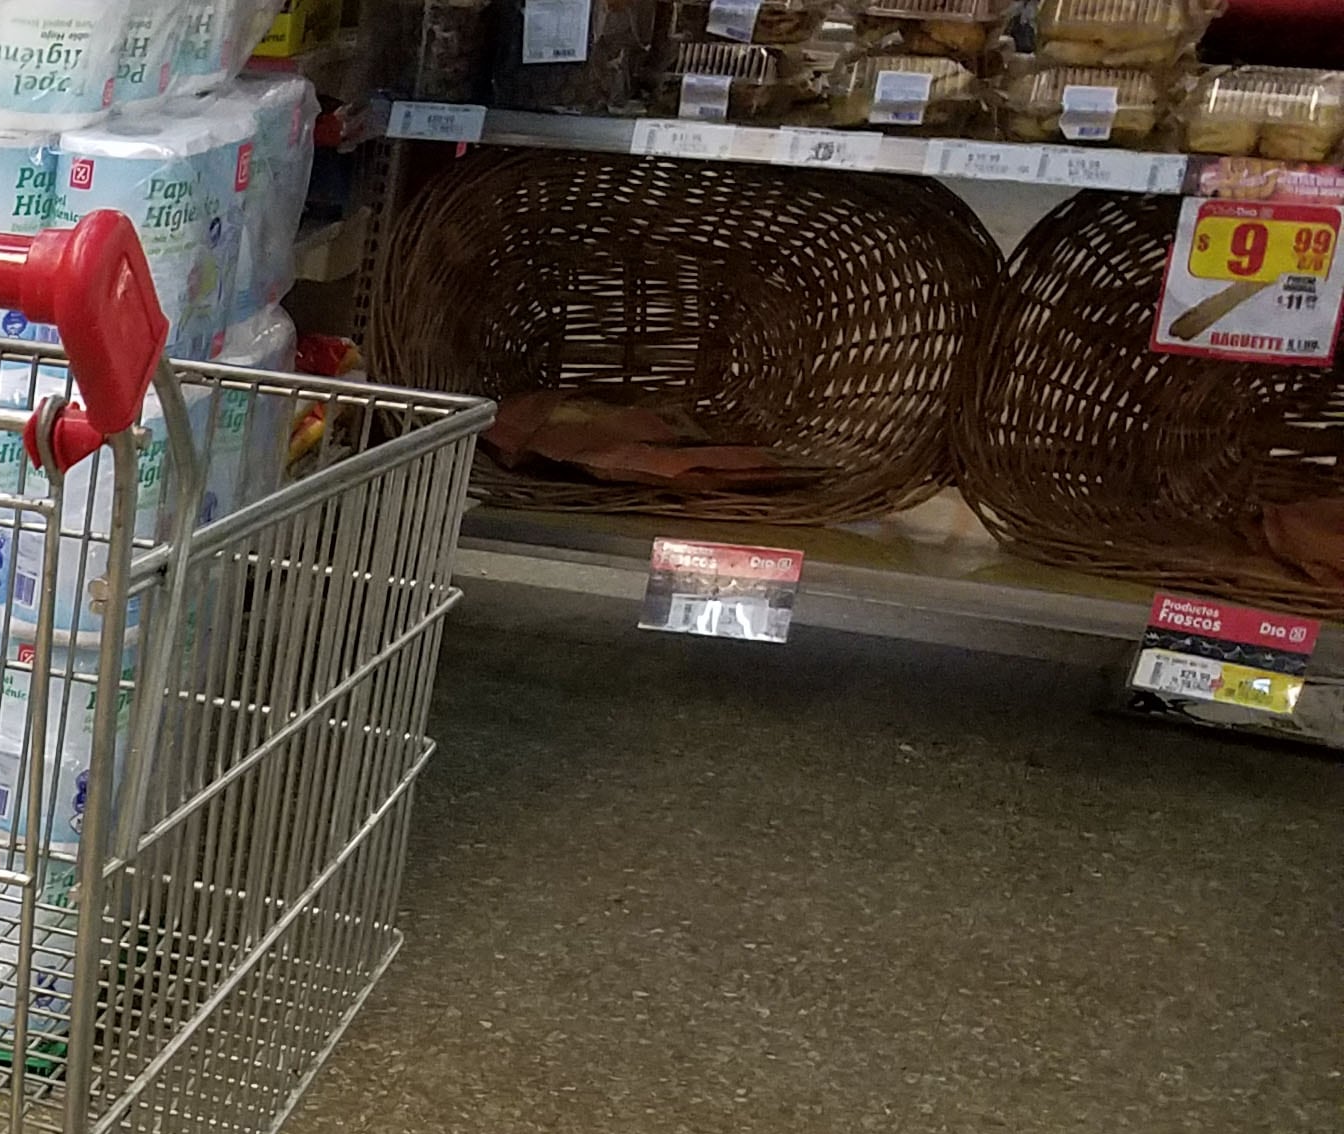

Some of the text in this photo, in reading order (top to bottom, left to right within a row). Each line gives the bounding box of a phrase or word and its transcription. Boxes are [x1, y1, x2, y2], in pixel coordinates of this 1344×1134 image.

[1197, 234, 1210, 252] $
[1227, 223, 1269, 277] 9
[1294, 227, 1332, 254] 99
[1158, 608, 1286, 639] Frescos Dia
[1162, 599, 1221, 619] Productos
